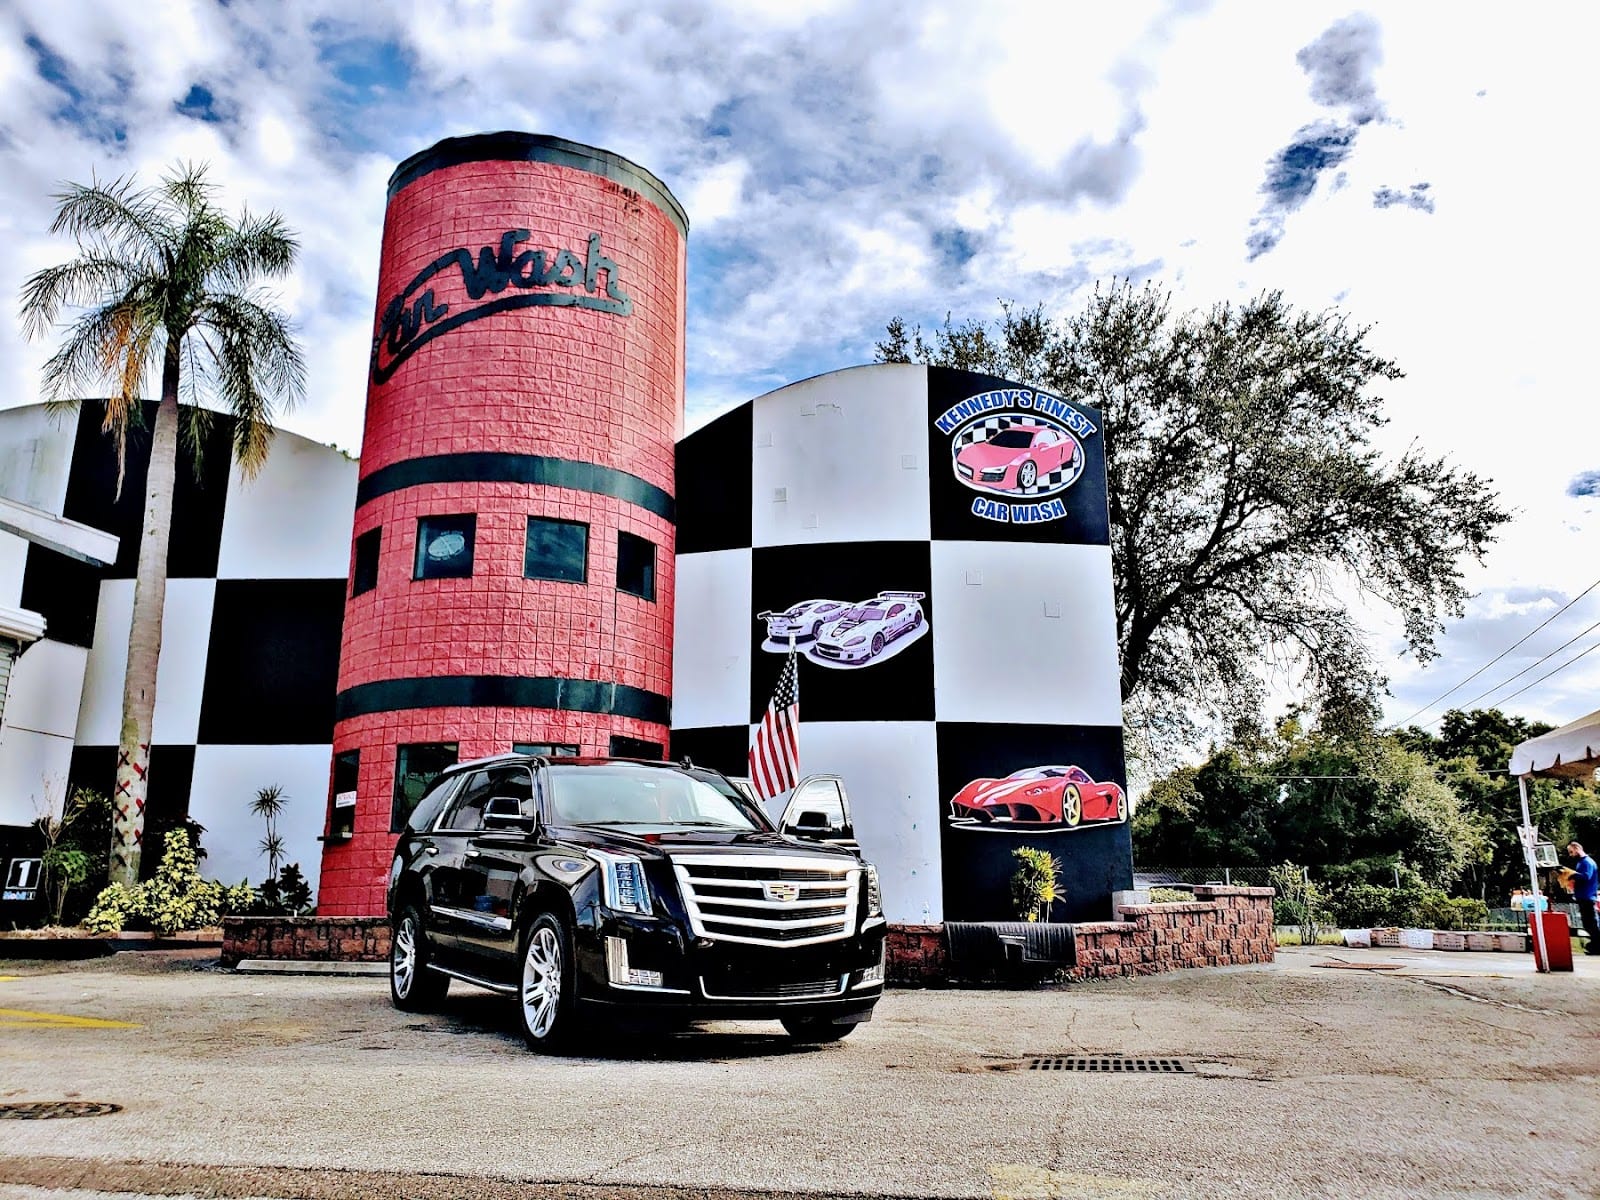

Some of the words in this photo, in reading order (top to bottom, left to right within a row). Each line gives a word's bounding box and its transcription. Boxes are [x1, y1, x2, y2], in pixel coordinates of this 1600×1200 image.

[457, 228, 632, 303] Wash
[935, 389, 1033, 435] KENNEDY'S
[1034, 392, 1097, 439] FINEST
[971, 497, 1009, 523] CAR
[1011, 498, 1067, 524] WASH
[18, 860, 32, 887] 1
